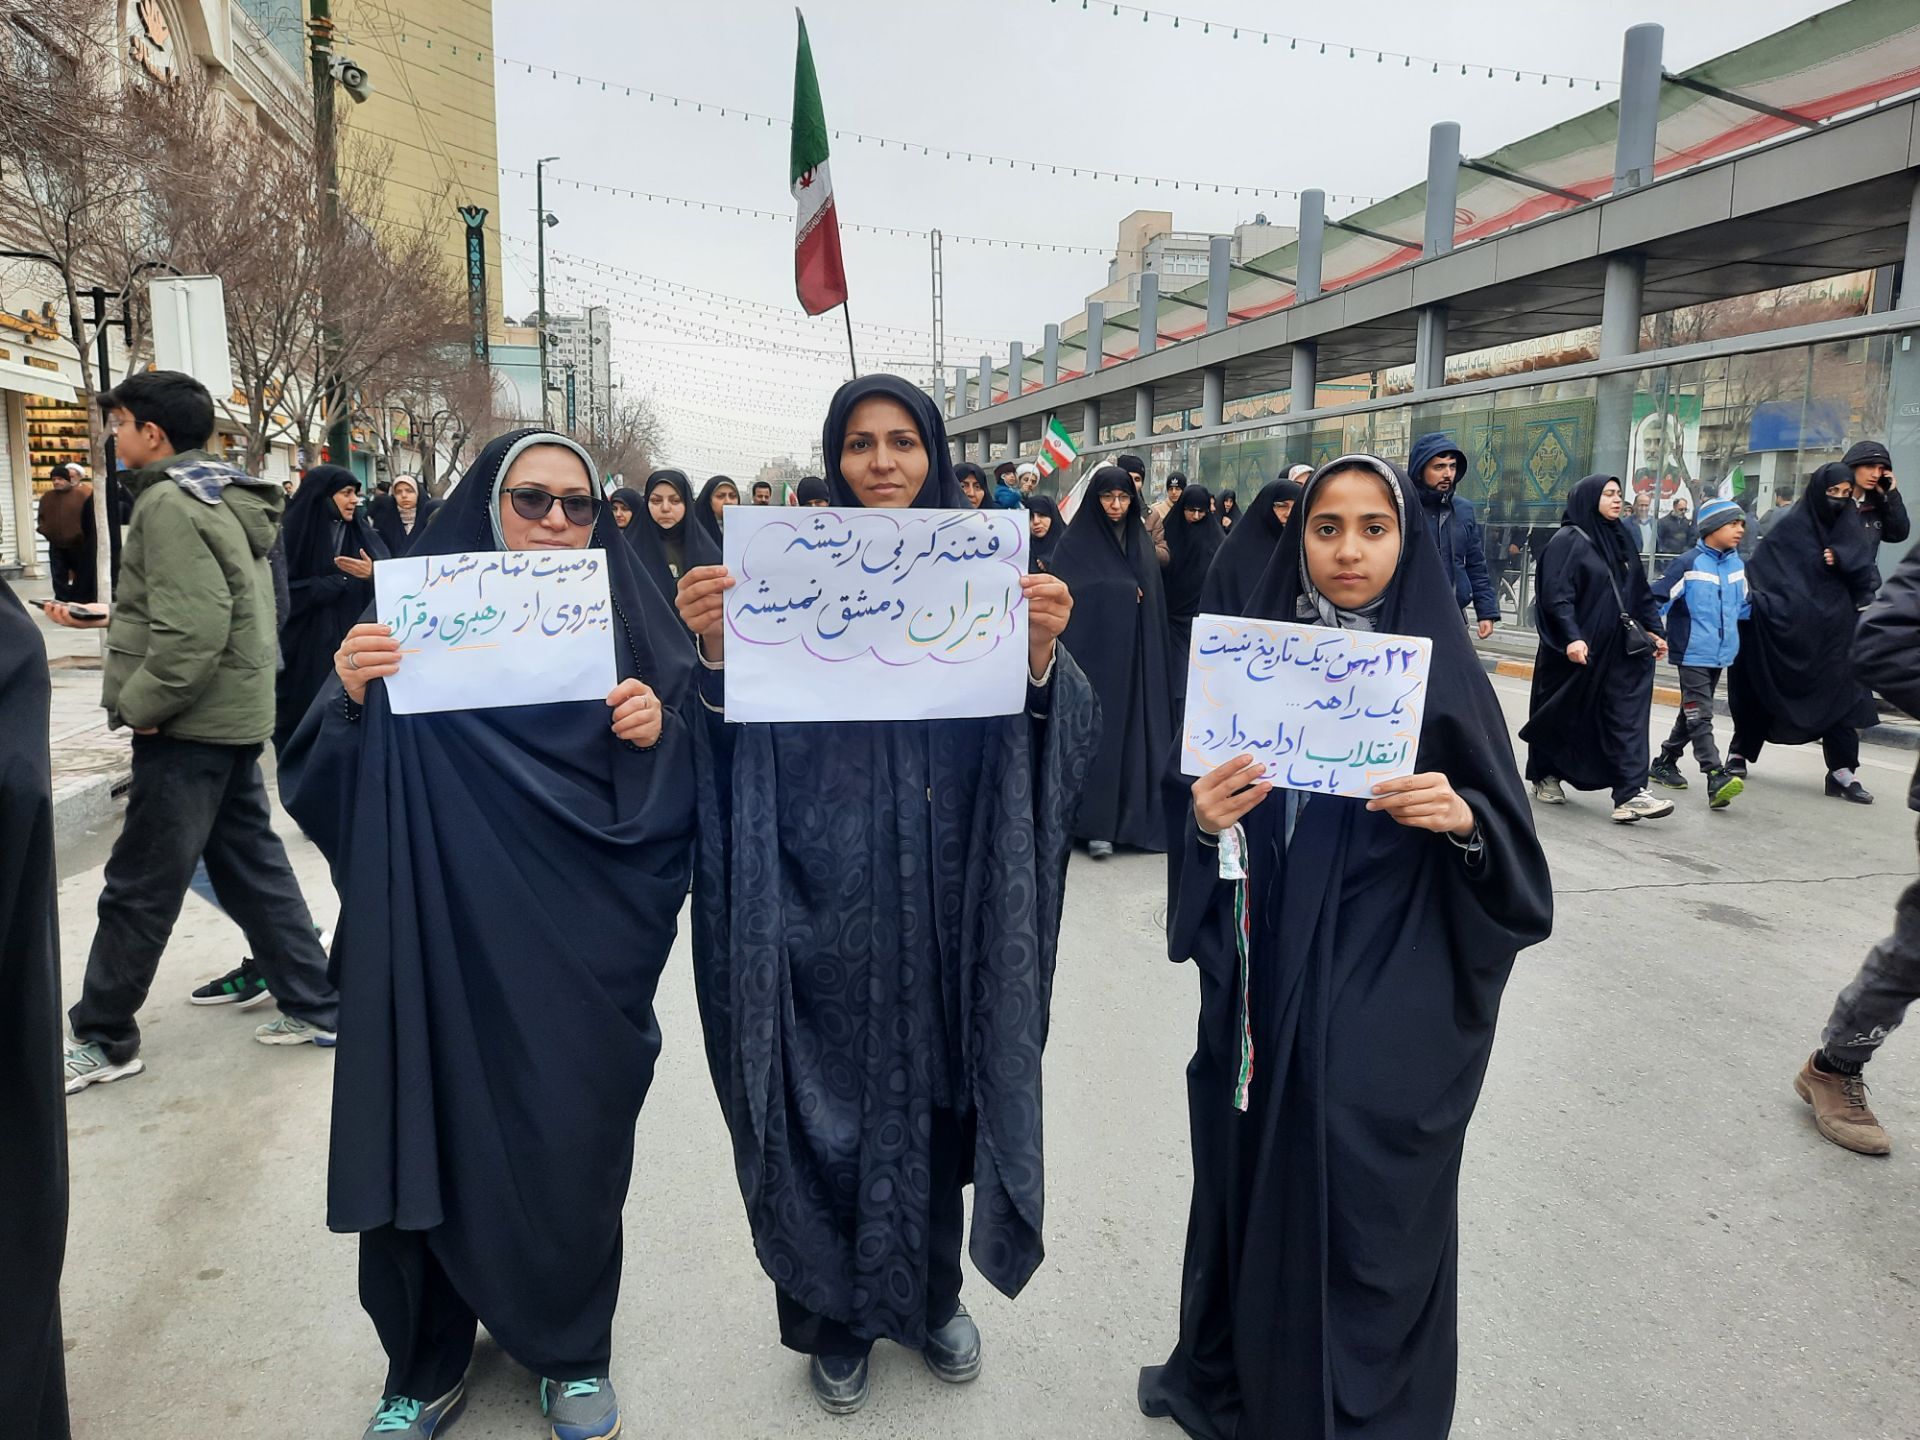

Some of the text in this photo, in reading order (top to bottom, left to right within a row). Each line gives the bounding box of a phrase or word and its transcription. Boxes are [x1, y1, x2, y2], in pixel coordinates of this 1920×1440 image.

[783, 518, 862, 568] ریشه
[860, 536, 905, 575] بی
[415, 552, 599, 600] وصیت تمام شهدا
[439, 604, 507, 646] رهبری
[512, 590, 541, 634] از
[541, 598, 611, 637] پیروی
[735, 578, 1011, 652] ایران دمشق نمیشه
[1199, 633, 1252, 662] نیست
[1246, 637, 1300, 682] تاریخ
[1295, 638, 1345, 672] یک
[1384, 646, 1418, 675] ۲۲
[1364, 681, 1422, 725] یک
[1248, 721, 1306, 756] ادامه
[1305, 740, 1409, 770] انقلاب
[1286, 762, 1324, 789] ما
[1328, 769, 1340, 793] با
